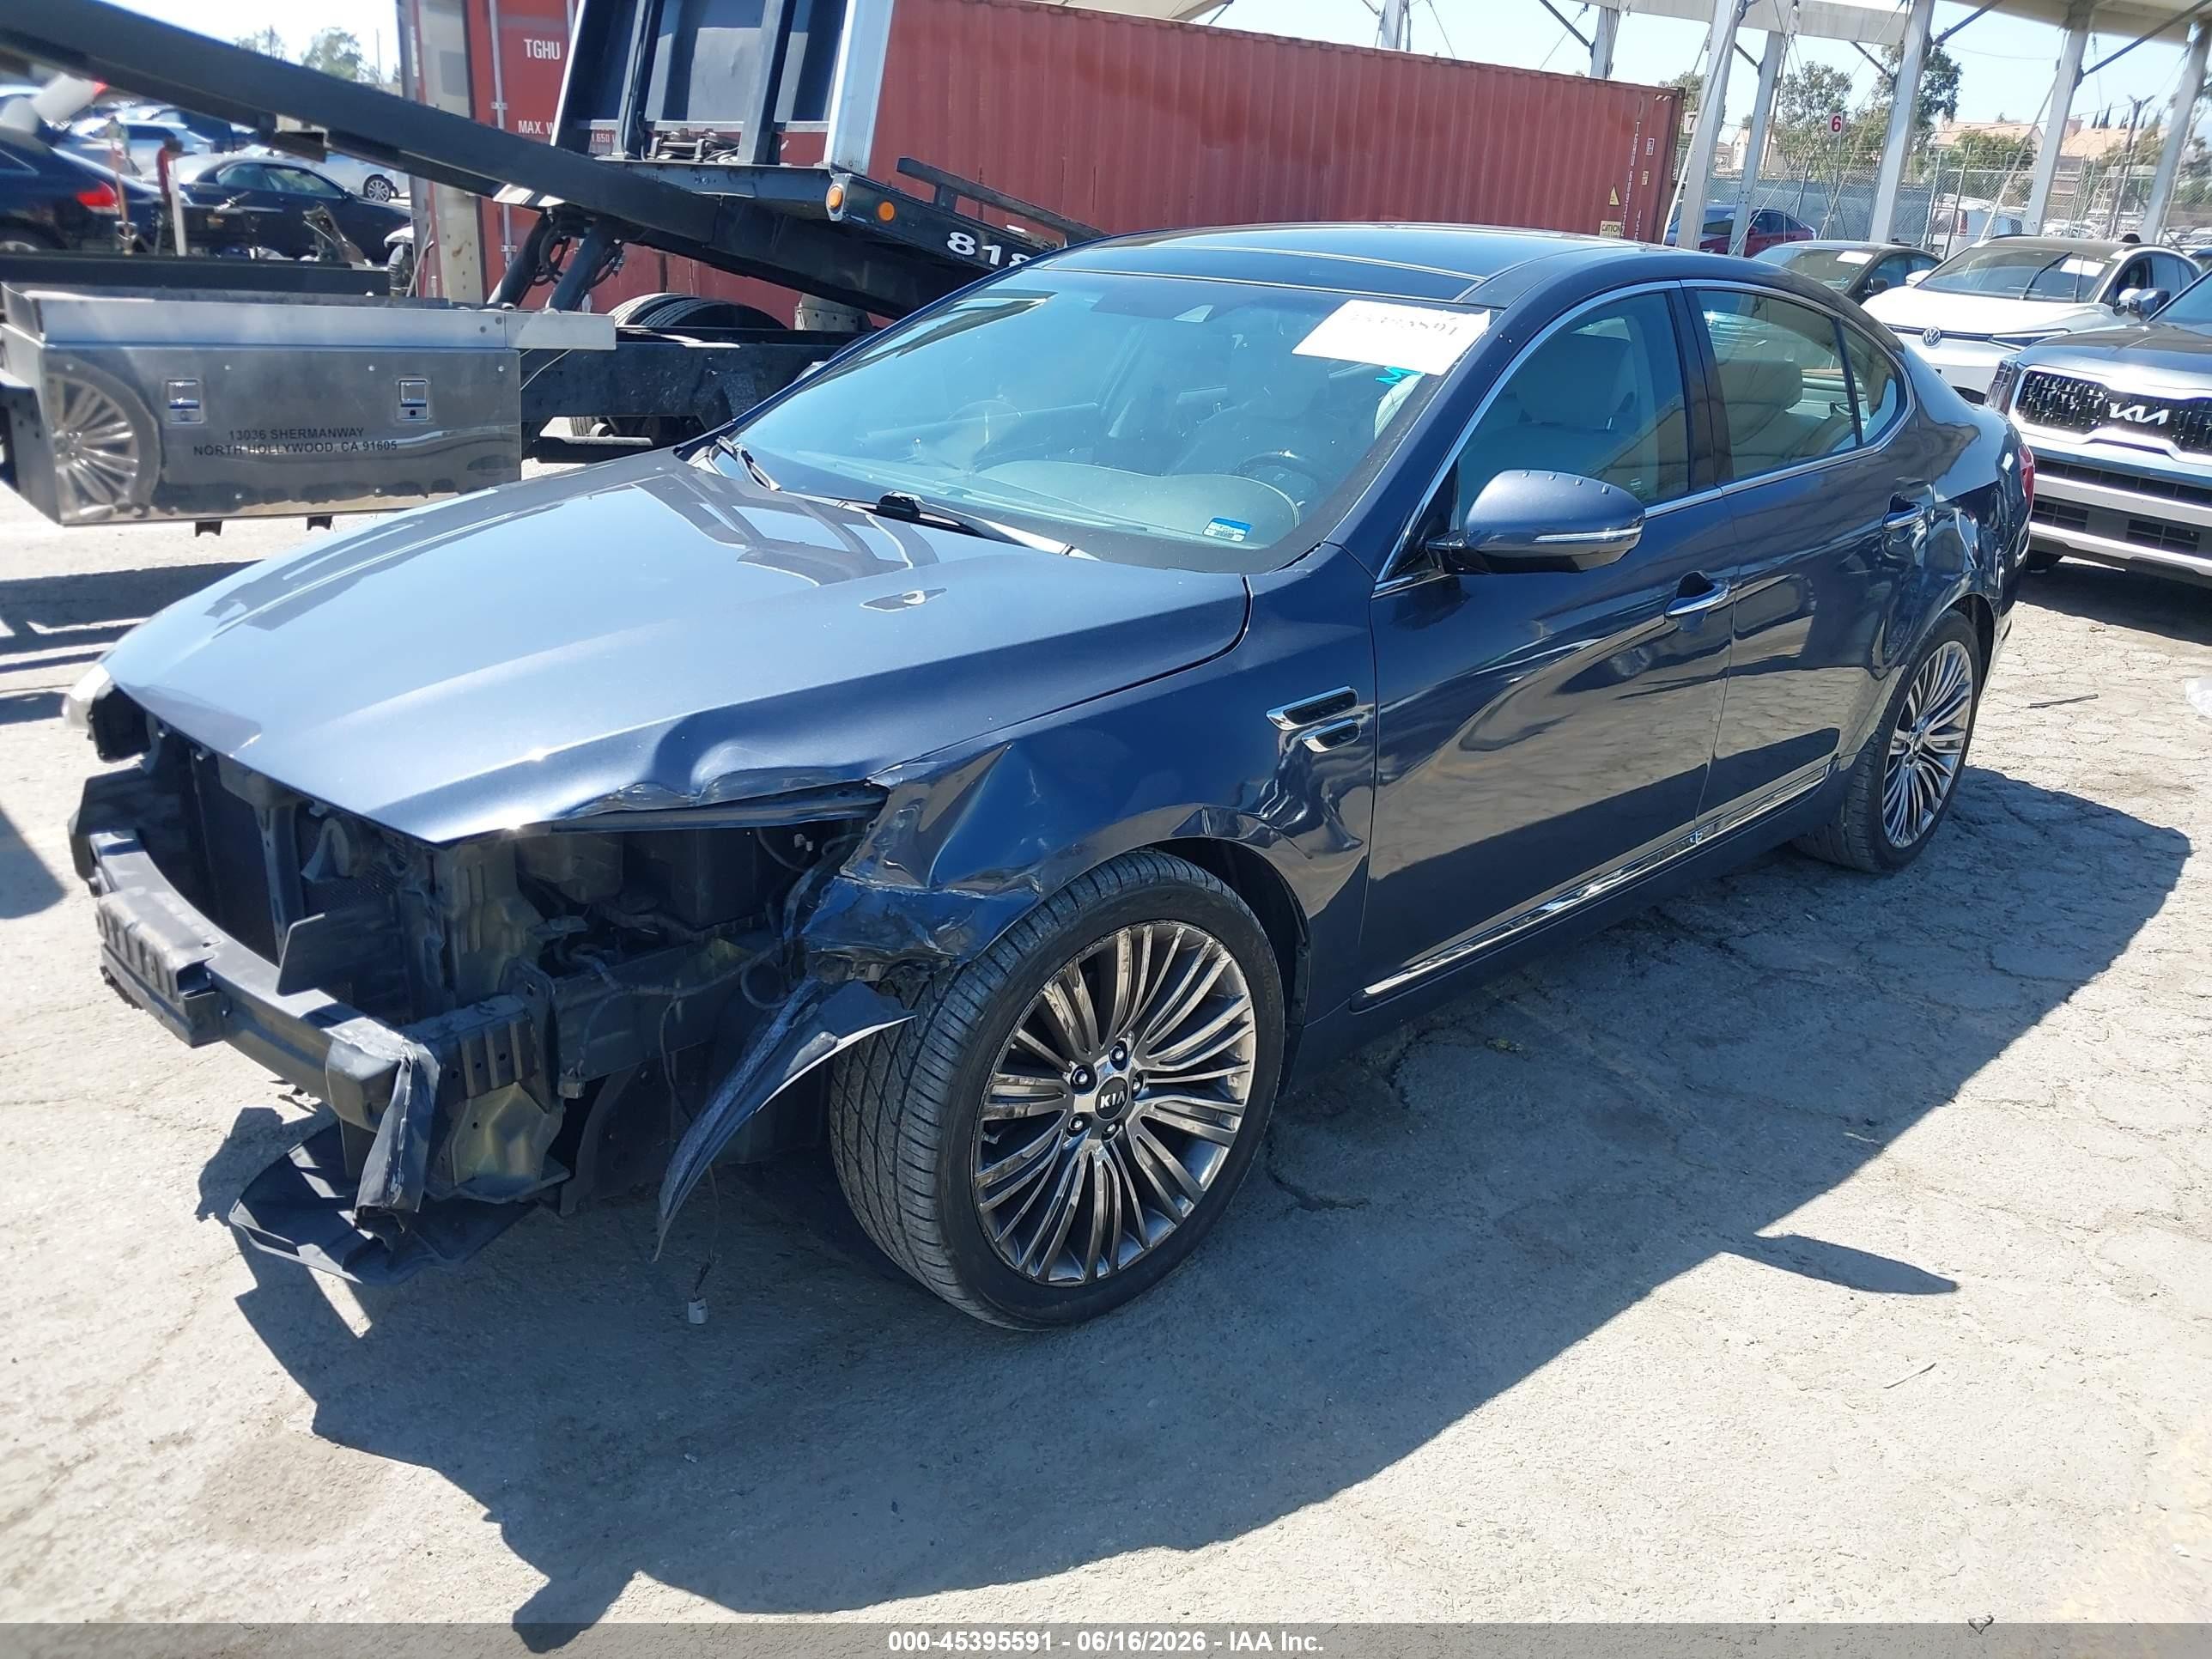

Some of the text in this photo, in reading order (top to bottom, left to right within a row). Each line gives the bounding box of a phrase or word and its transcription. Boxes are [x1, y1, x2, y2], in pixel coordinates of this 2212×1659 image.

[524, 39, 561, 60] TGHU
[518, 120, 544, 134] MAX.
[1687, 114, 1697, 131] 7
[1831, 115, 1842, 132] 6
[228, 428, 266, 441] 13036
[193, 445, 247, 456] NORTH
[341, 441, 358, 452] CA
[362, 440, 398, 452] 91605
[1100, 1091, 1125, 1109] KIA
